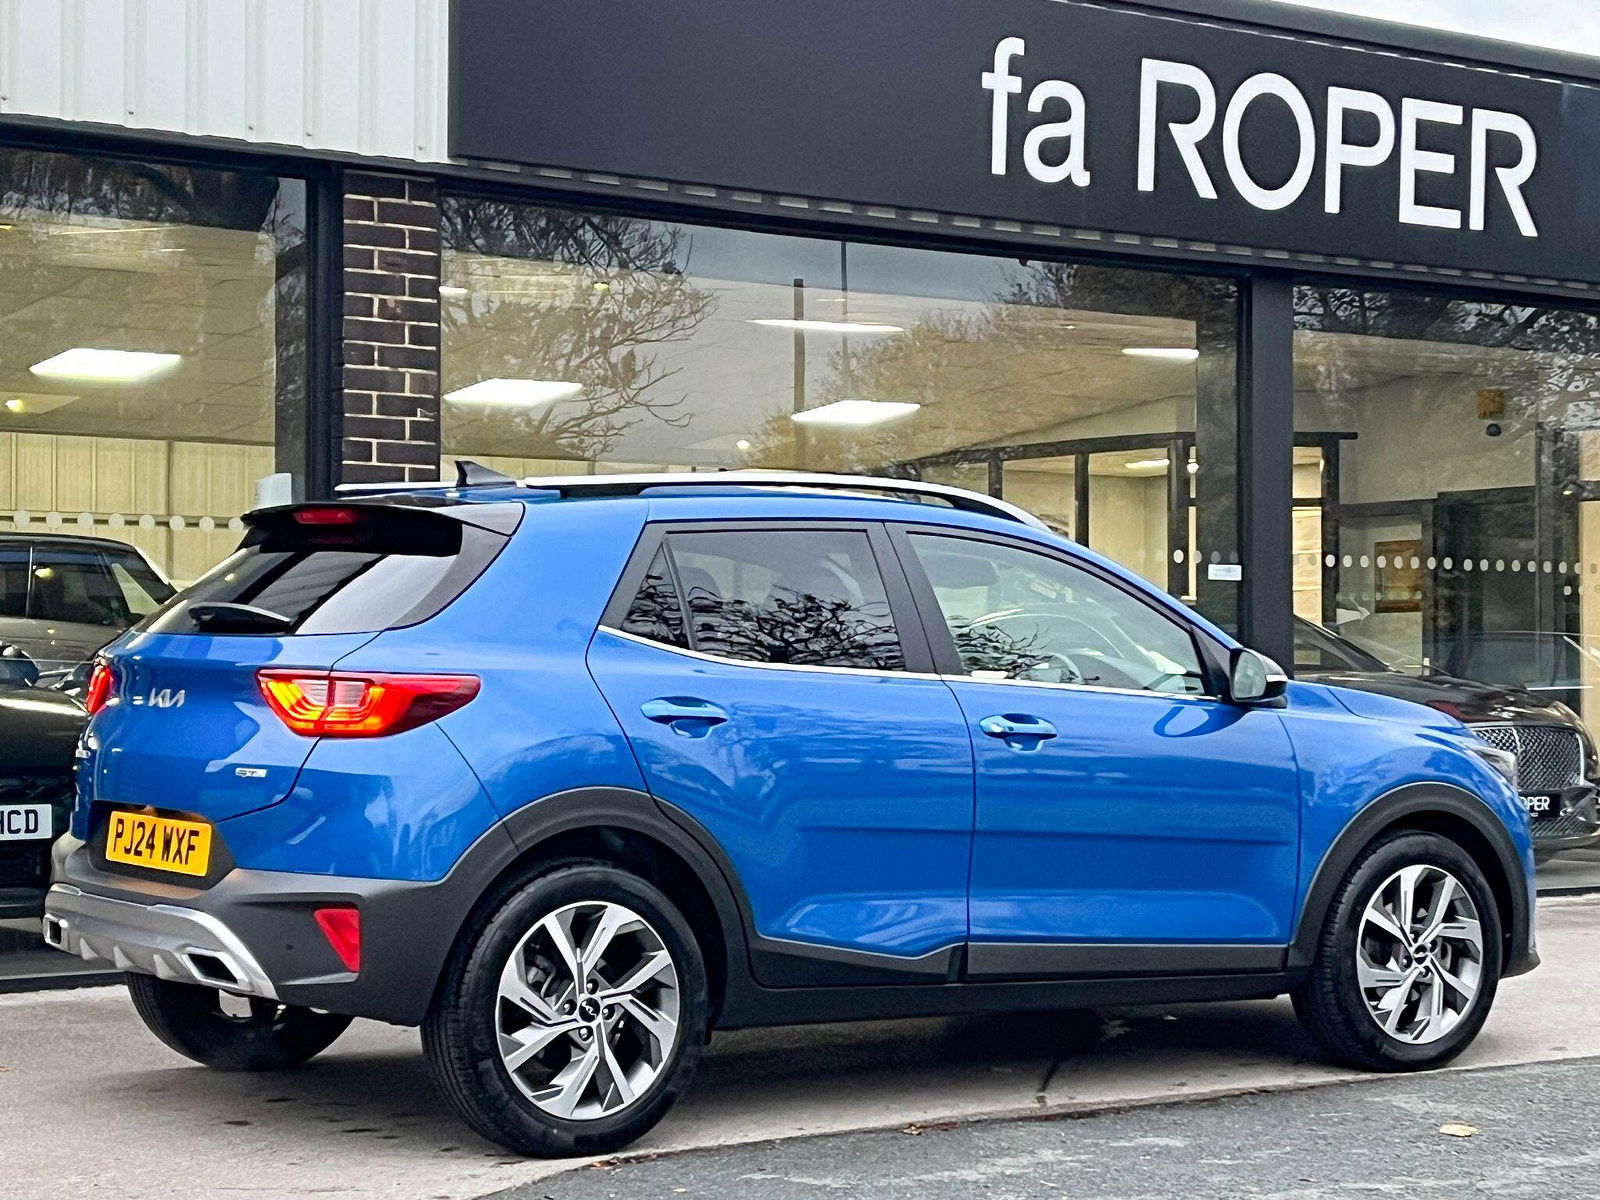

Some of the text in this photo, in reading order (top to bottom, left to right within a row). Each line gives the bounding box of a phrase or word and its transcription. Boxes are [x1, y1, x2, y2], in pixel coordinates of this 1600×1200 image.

[981, 36, 1539, 238] fa ROPER
[148, 687, 186, 708] KIA
[112, 817, 200, 866] PJ24 WXF
